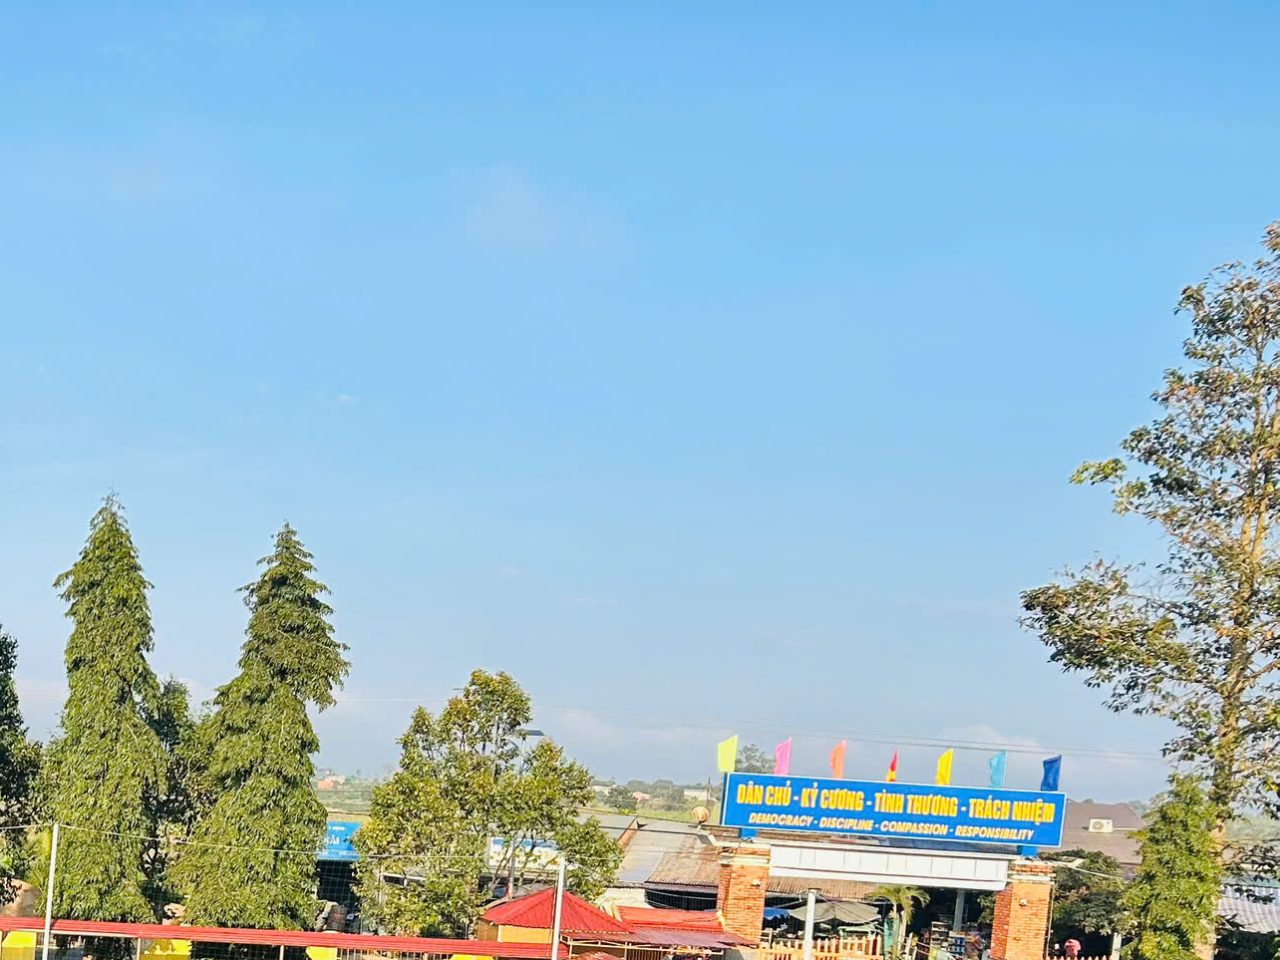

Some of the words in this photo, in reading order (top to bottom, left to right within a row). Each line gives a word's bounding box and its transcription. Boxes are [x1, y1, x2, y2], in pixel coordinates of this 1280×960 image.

[737, 780, 764, 804] DÂN
[765, 780, 792, 806] CHỦ
[800, 782, 819, 808] KỶ
[820, 788, 865, 811] CƯƠNG
[874, 789, 904, 814] TÌNH
[906, 793, 959, 817] THƯƠNG
[969, 794, 1011, 821] TRÁCH
[1012, 798, 1055, 826] NHIỆM
[749, 812, 814, 828] DEMOCRACY
[819, 817, 874, 831] DISCIPLINE
[880, 820, 948, 836] COMPASSION
[955, 826, 1035, 841] RESPONSIBILITY
